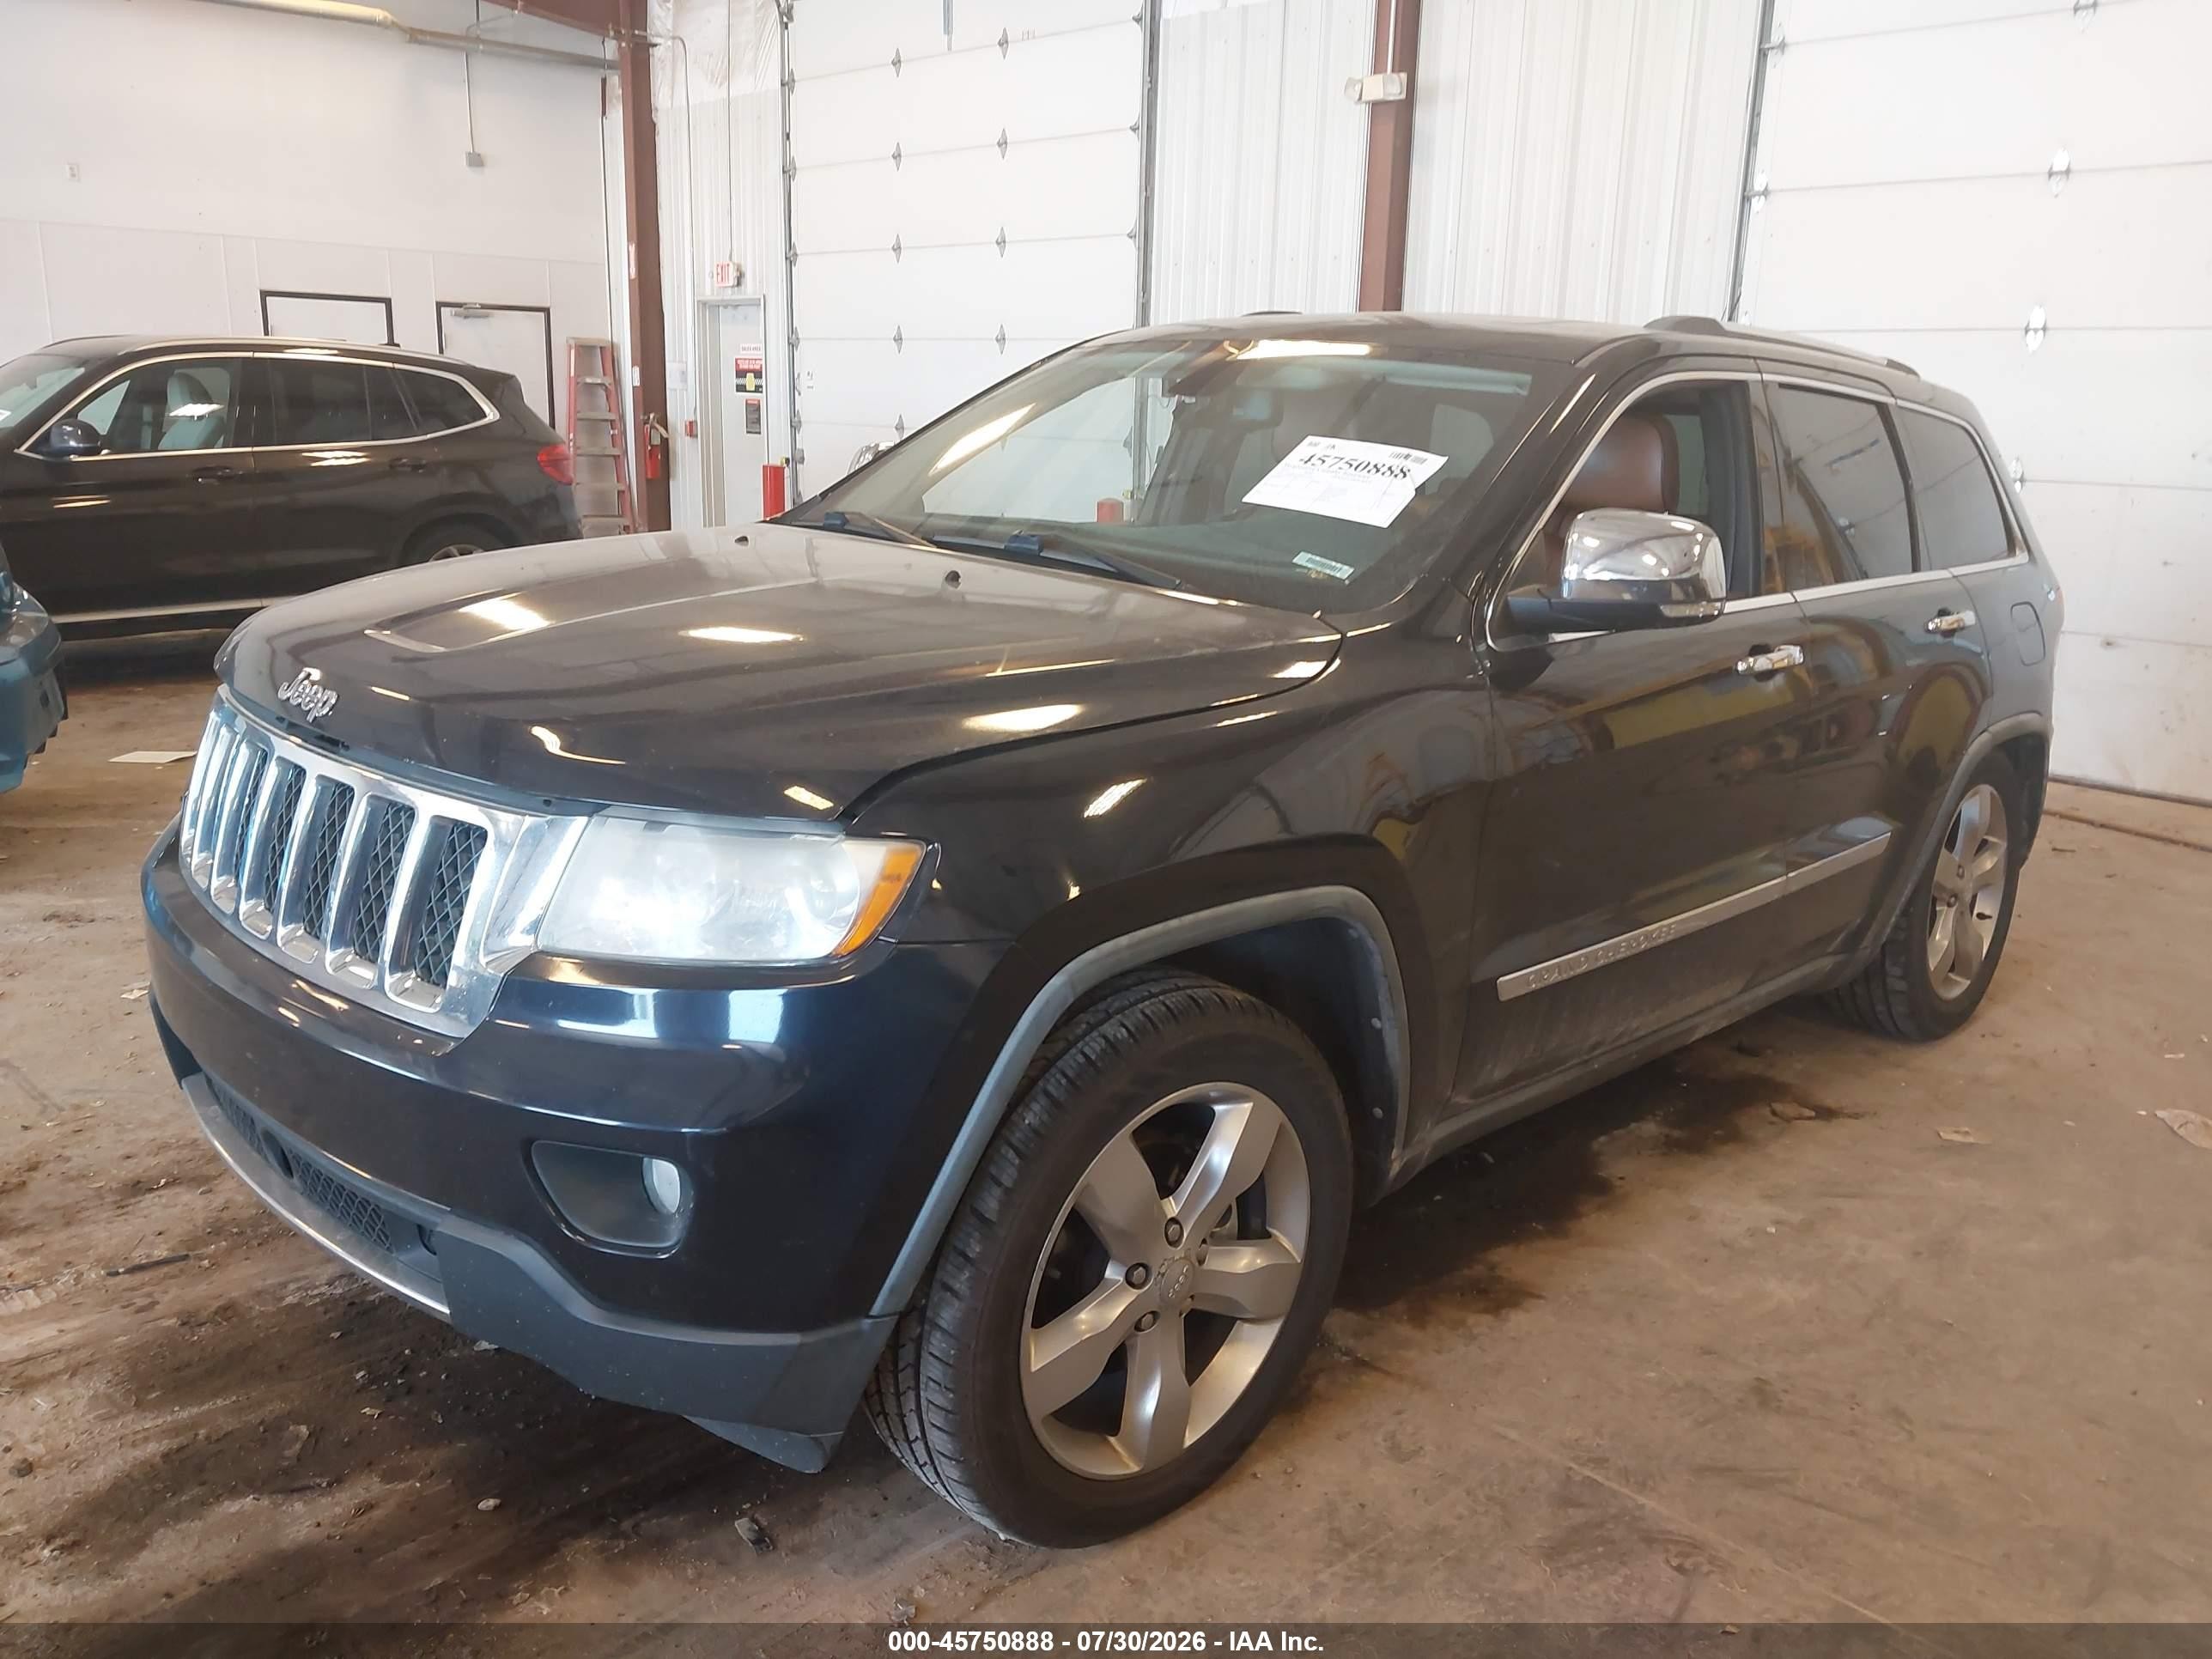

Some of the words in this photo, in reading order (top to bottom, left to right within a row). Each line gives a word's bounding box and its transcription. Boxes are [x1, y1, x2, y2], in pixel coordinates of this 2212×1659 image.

[716, 263, 731, 284] EXIT
[1298, 453, 1411, 480] 45750888
[278, 667, 337, 723] Jeep
